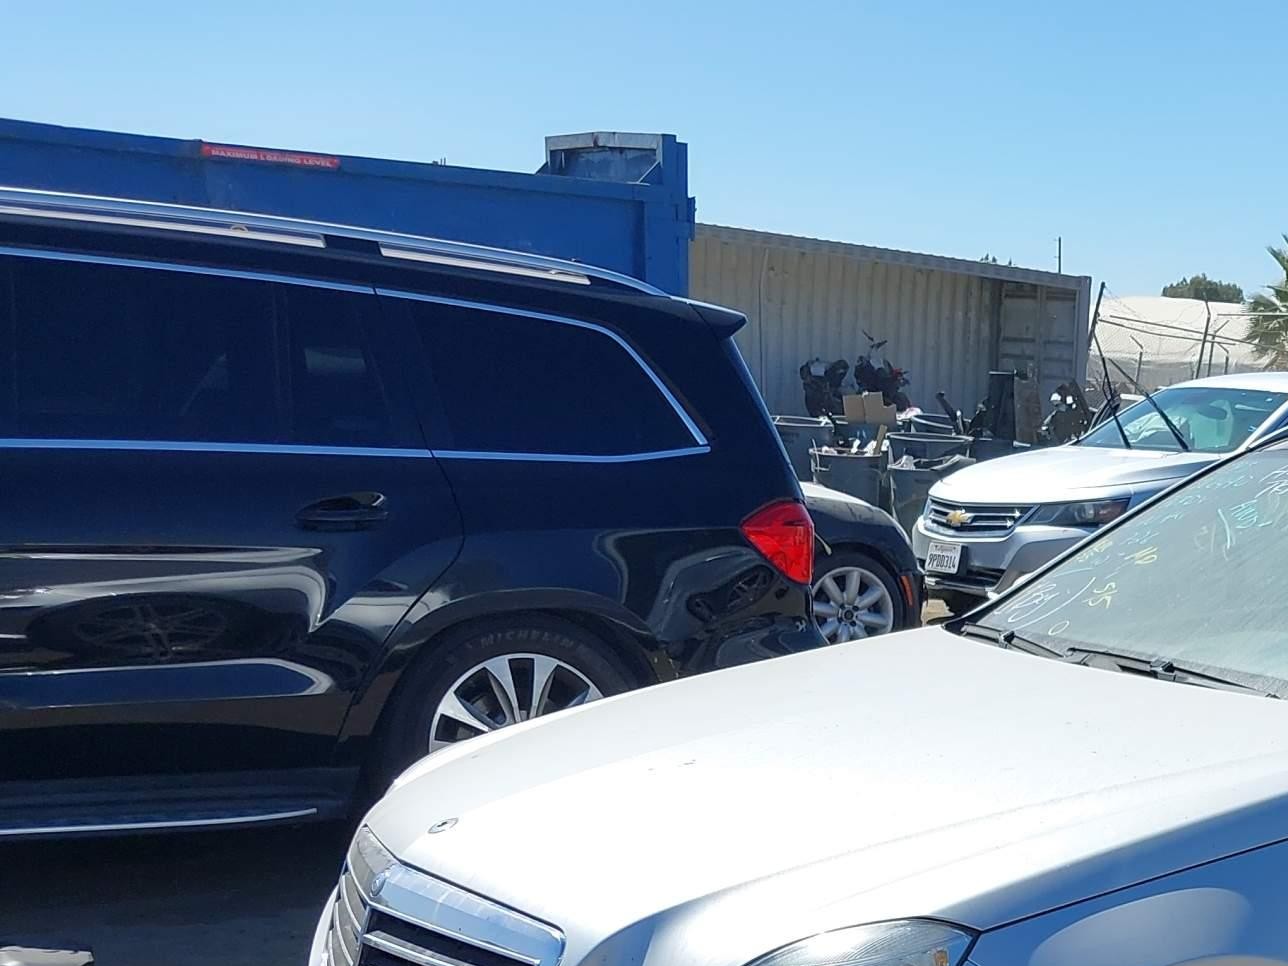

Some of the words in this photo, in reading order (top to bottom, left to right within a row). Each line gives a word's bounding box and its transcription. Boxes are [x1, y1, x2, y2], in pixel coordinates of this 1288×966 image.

[211, 148, 259, 161] MAXIMUM
[259, 153, 301, 165] LOADING
[303, 158, 332, 168] LEVEL
